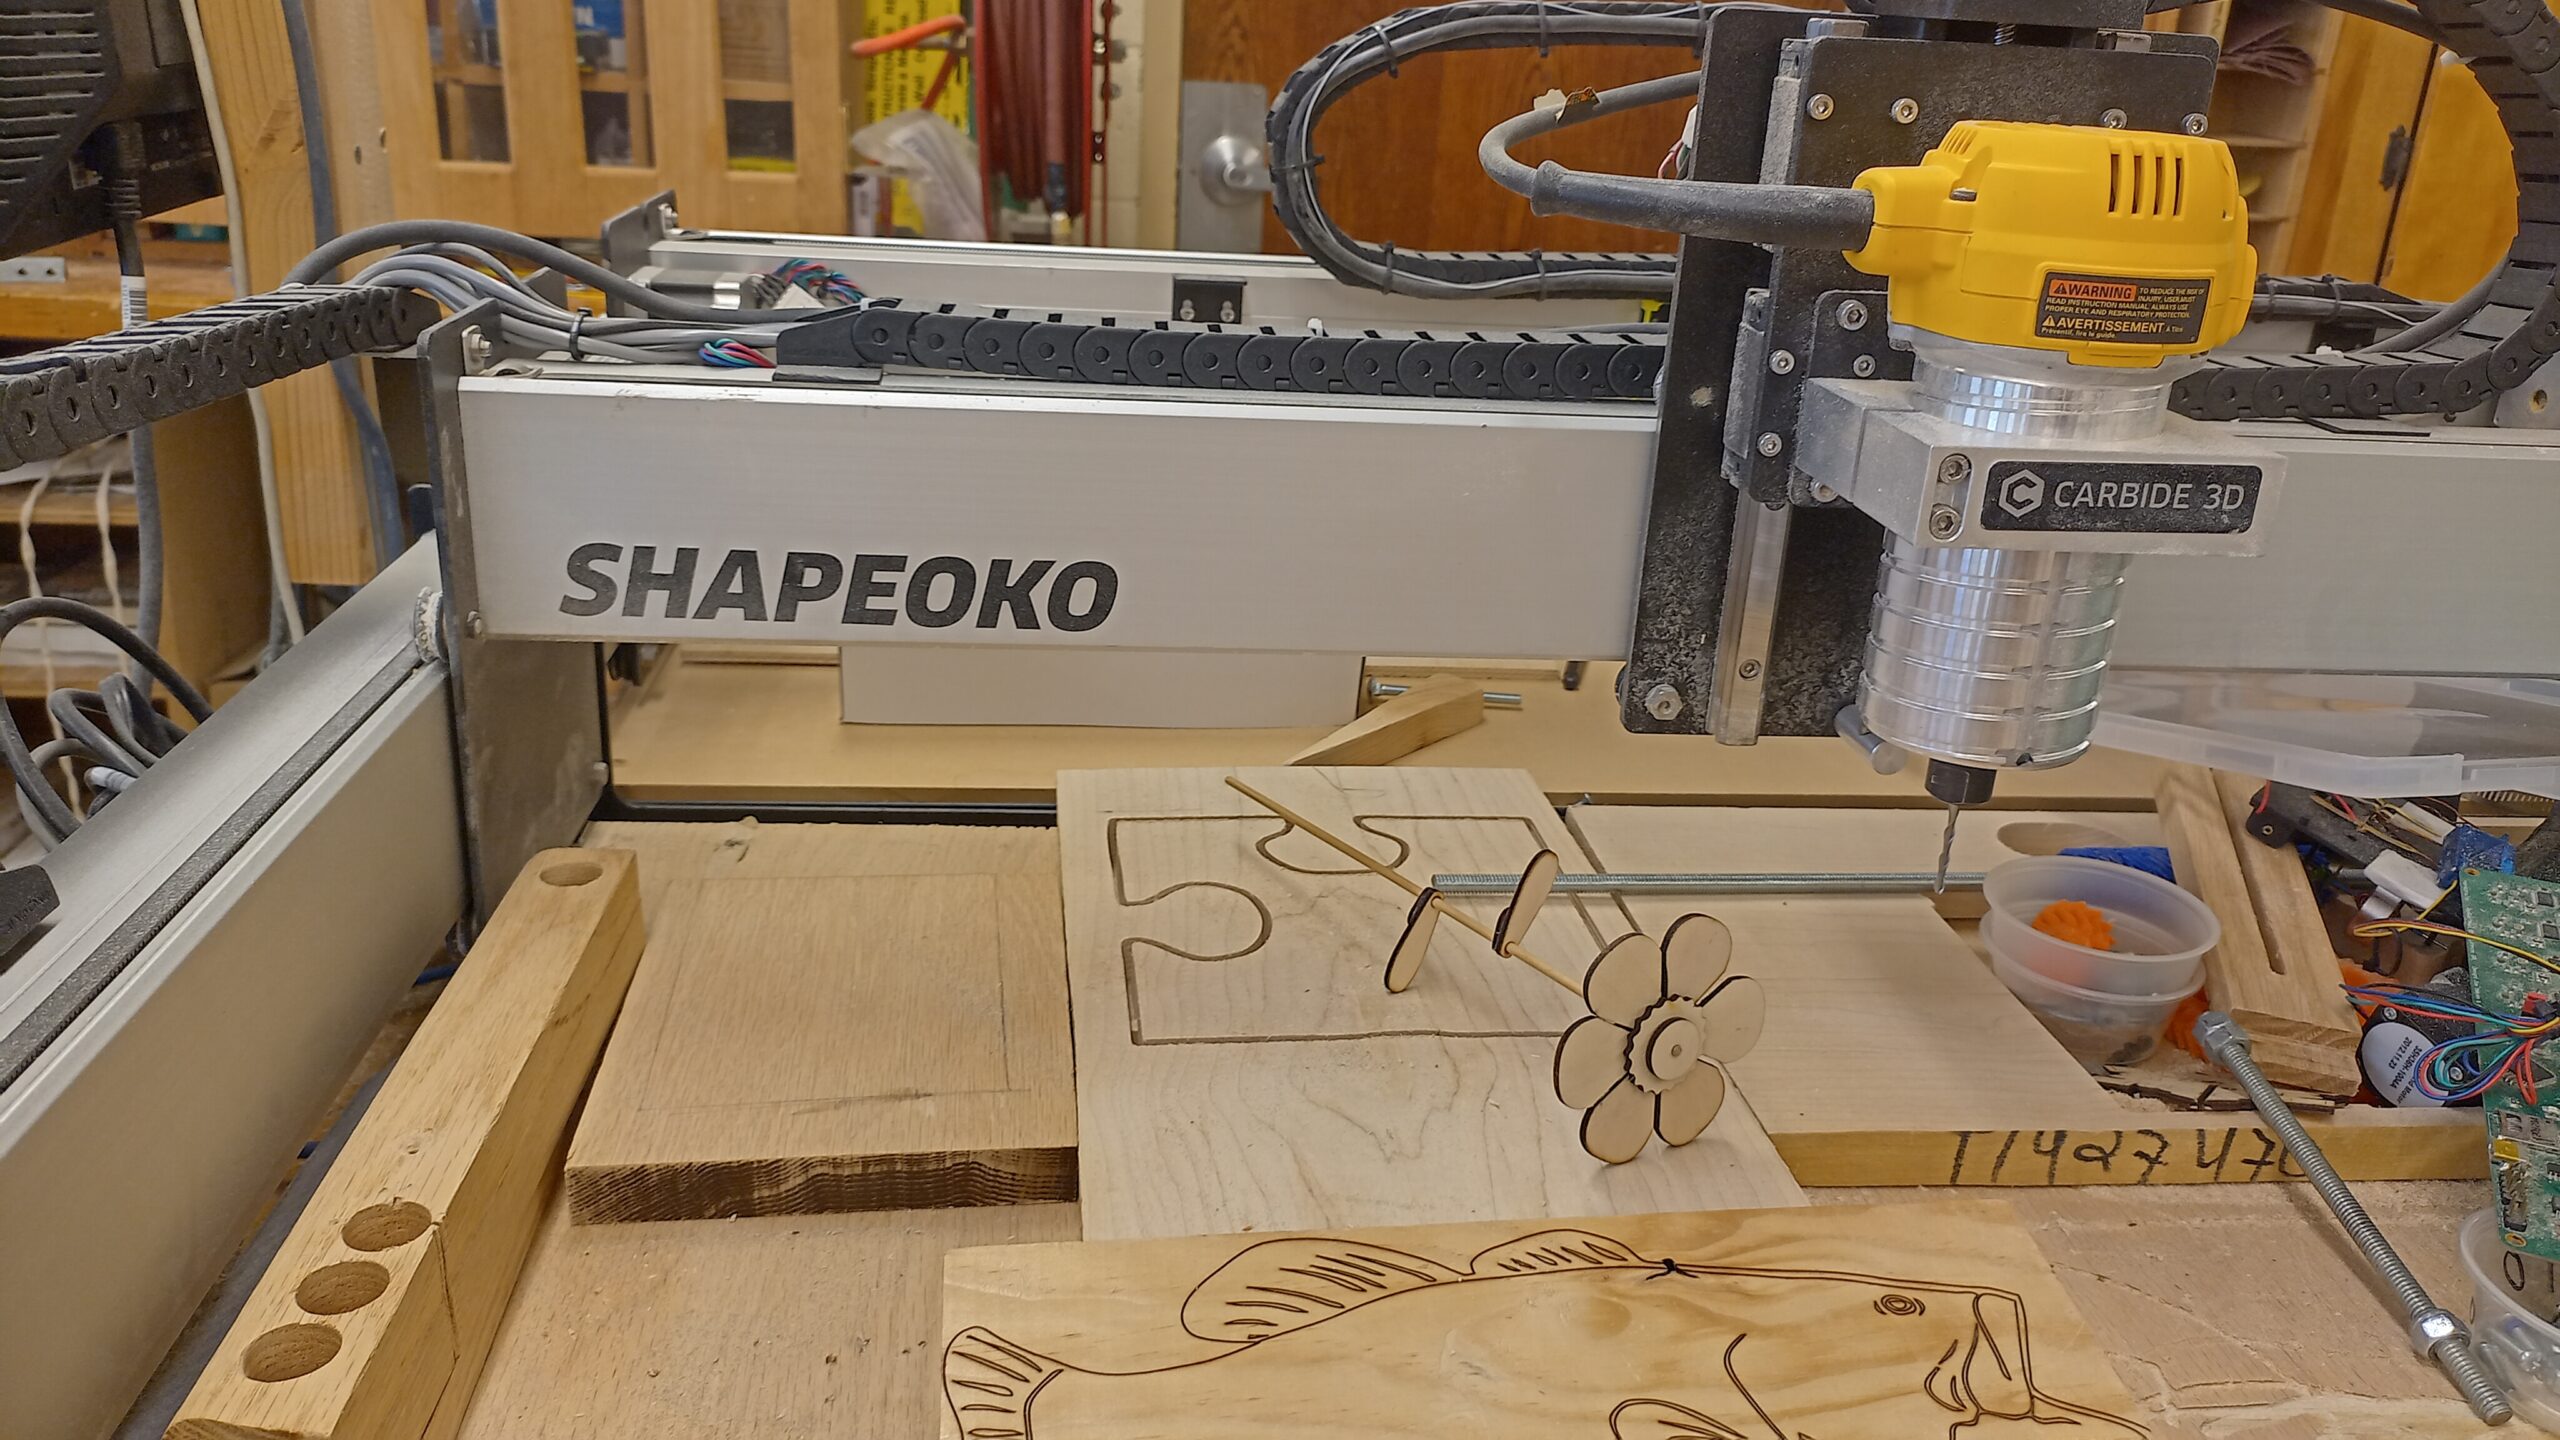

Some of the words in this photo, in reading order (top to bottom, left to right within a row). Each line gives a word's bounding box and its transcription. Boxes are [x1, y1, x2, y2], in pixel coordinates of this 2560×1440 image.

[2068, 283, 2132, 299] WARNING
[2045, 305, 2074, 313] PROPER
[2090, 308, 2107, 316] AND
[2108, 309, 2155, 318] RESPIRATORY
[2067, 298, 2117, 308] INSTRUCTION
[2151, 303, 2177, 311] ALWAYS
[2057, 317, 2165, 333] AVERTISSEMENT
[2053, 481, 2193, 509] CARBIDE
[2203, 483, 2245, 510] 3D
[559, 542, 1119, 632] SHAPEOKO
